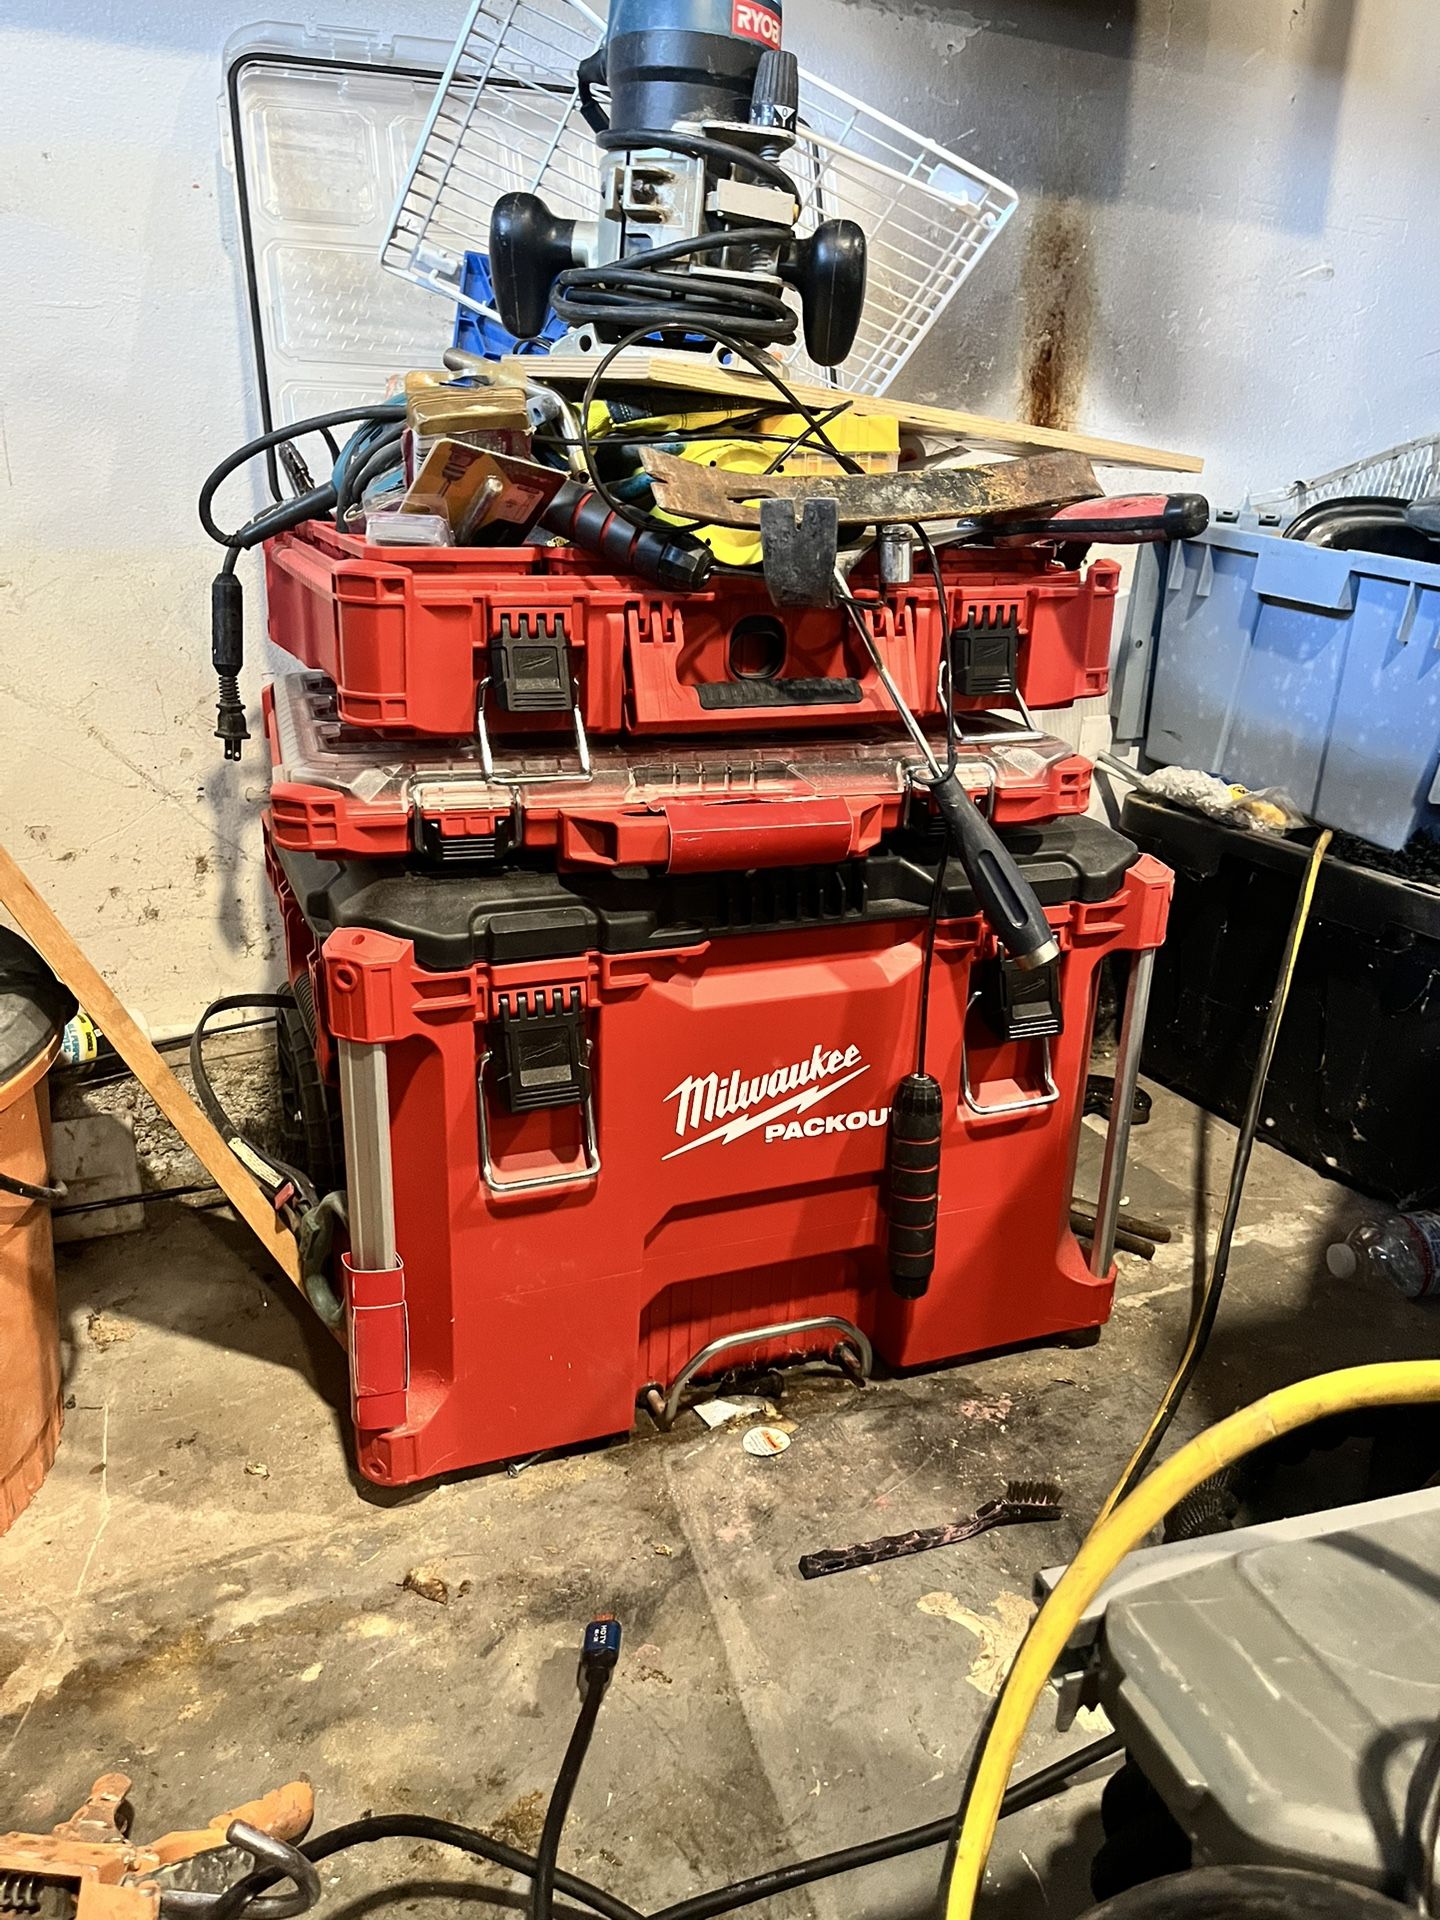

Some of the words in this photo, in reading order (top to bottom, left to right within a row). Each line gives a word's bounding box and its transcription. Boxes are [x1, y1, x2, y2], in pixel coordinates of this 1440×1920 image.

[736, 4, 780, 46] RYOB
[663, 1044, 862, 1137] Milwaukee
[764, 1107, 892, 1143] PACKOU
